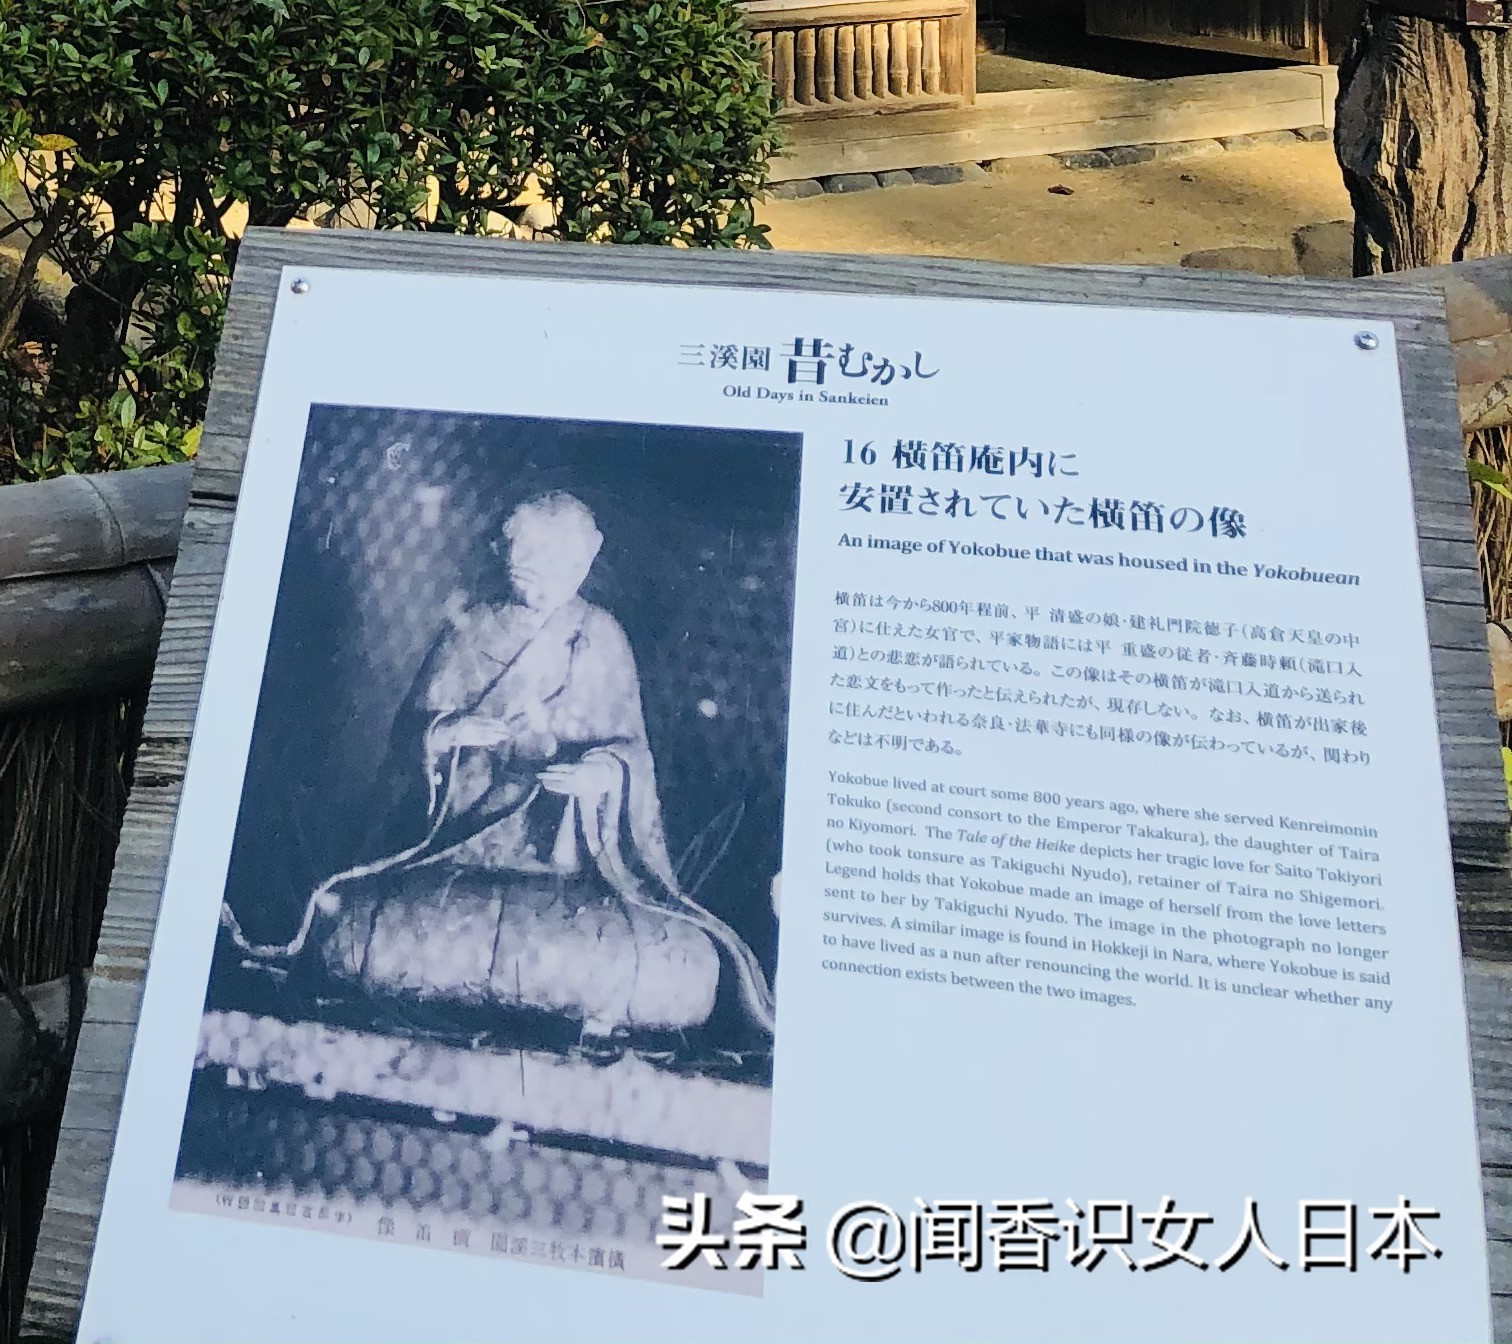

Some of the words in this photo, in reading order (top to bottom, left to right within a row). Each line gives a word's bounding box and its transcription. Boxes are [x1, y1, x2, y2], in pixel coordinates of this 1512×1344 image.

[676, 343, 771, 373] 三溪園
[779, 335, 940, 386] 昔むかし
[722, 384, 751, 399] Old
[755, 386, 794, 404] Days
[797, 389, 814, 402] in
[818, 389, 888, 406] Sankeien
[842, 438, 877, 465] 16
[891, 438, 1079, 477] 横笛庵内に
[838, 481, 1247, 539] 安置されていた横笛の像
[837, 532, 862, 547] An
[867, 534, 922, 554] image
[926, 539, 946, 553] of
[948, 540, 1030, 559] Yokobue
[1034, 546, 1073, 563] that
[1076, 552, 1114, 566] was
[1117, 551, 1188, 572] housed
[1192, 557, 1212, 574] in
[1215, 560, 1248, 576] the
[1253, 562, 1360, 586] Yokobuean
[826, 792, 881, 809] Tokuko
[885, 798, 942, 816] (second
[946, 807, 1002, 822] consort
[1006, 812, 1022, 824] to
[1026, 812, 1050, 827] the
[1056, 815, 1123, 834] Emperor
[1213, 832, 1238, 847] the
[1243, 835, 1313, 856] daughter
[1318, 843, 1335, 857] of
[1337, 845, 1379, 862] Taira
[828, 769, 888, 788] Yokobue
[892, 775, 926, 792] lived
[930, 782, 945, 795] at
[947, 784, 987, 800] court
[990, 789, 1029, 802] some
[1032, 790, 1061, 805] 800
[1064, 796, 1105, 810] years
[1142, 802, 1189, 819] where
[1193, 807, 1219, 821] she
[1223, 813, 1274, 828] served
[1278, 815, 1378, 838] Kenreimonin
[825, 837, 864, 853] (who
[868, 843, 901, 858] took
[906, 847, 964, 865] tonsure
[969, 856, 985, 867] as
[990, 855, 1065, 876] Takiguchi
[1136, 874, 1201, 890] retainer
[1205, 879, 1222, 893] of
[1225, 880, 1268, 898] Taira
[1273, 888, 1295, 901] no
[826, 818, 844, 829] no
[924, 825, 952, 840] The
[957, 828, 987, 843] Tale
[990, 832, 1008, 848] of
[1008, 833, 1031, 848] the
[1035, 836, 1075, 853] Heike
[1079, 840, 1132, 860] depicts
[1136, 847, 1162, 863] her
[1165, 852, 1209, 870] tragic
[1212, 854, 1244, 872] love
[1248, 859, 1271, 874] for
[1274, 862, 1312, 879] Saito
[1315, 866, 1382, 887] Tokiyori
[823, 887, 855, 900] sent
[860, 889, 875, 902] to
[880, 889, 906, 905] her
[911, 893, 929, 911] by
[933, 896, 1008, 918] Takiguchi
[1072, 911, 1103, 928] The
[1108, 916, 1156, 937] image
[1160, 922, 1176, 937] in
[1181, 924, 1207, 940] the
[1212, 927, 1305, 953] photograph
[1310, 942, 1332, 954] no
[1336, 940, 1389, 963] longer
[825, 860, 876, 879] Legend
[881, 865, 921, 884] holds
[925, 871, 955, 887] that
[959, 875, 1024, 895] Yokobue
[1028, 885, 1070, 900] made
[1074, 891, 1094, 903] an
[1098, 890, 1144, 912] image
[1148, 897, 1165, 911] of
[1168, 898, 1222, 917] herself
[1226, 905, 1263, 922] from
[1268, 909, 1294, 926] the
[1297, 912, 1331, 929] love
[1335, 915, 1386, 935] letters
[821, 959, 901, 978] connection
[904, 967, 947, 983] exists
[950, 970, 1014, 992] between
[1018, 979, 1043, 995] the
[1045, 983, 1075, 999] two
[822, 933, 837, 946] to
[840, 933, 875, 951] have
[879, 937, 915, 956] lived
[919, 946, 935, 958] as
[939, 948, 948, 959] a
[952, 950, 981, 963] nun
[985, 951, 1021, 968] after
[1025, 958, 1111, 982] renouncing
[1114, 965, 1139, 982] the
[1197, 975, 1210, 990] It
[1213, 976, 1227, 992] is
[1231, 982, 1290, 999] unclear
[1293, 987, 1360, 1006] whether
[1364, 997, 1393, 1013] any
[889, 915, 901, 930] A
[904, 917, 956, 935] similar
[960, 923, 1004, 944] image
[1007, 928, 1020, 944] is
[1024, 930, 1068, 950] found
[1071, 935, 1086, 951] in
[1091, 938, 1149, 960] Hokkeji
[1152, 946, 1167, 960] in
[1216, 953, 1265, 972] where
[1269, 957, 1338, 980] Yokobue
[1341, 967, 1355, 981] is
[1358, 970, 1390, 985] said
